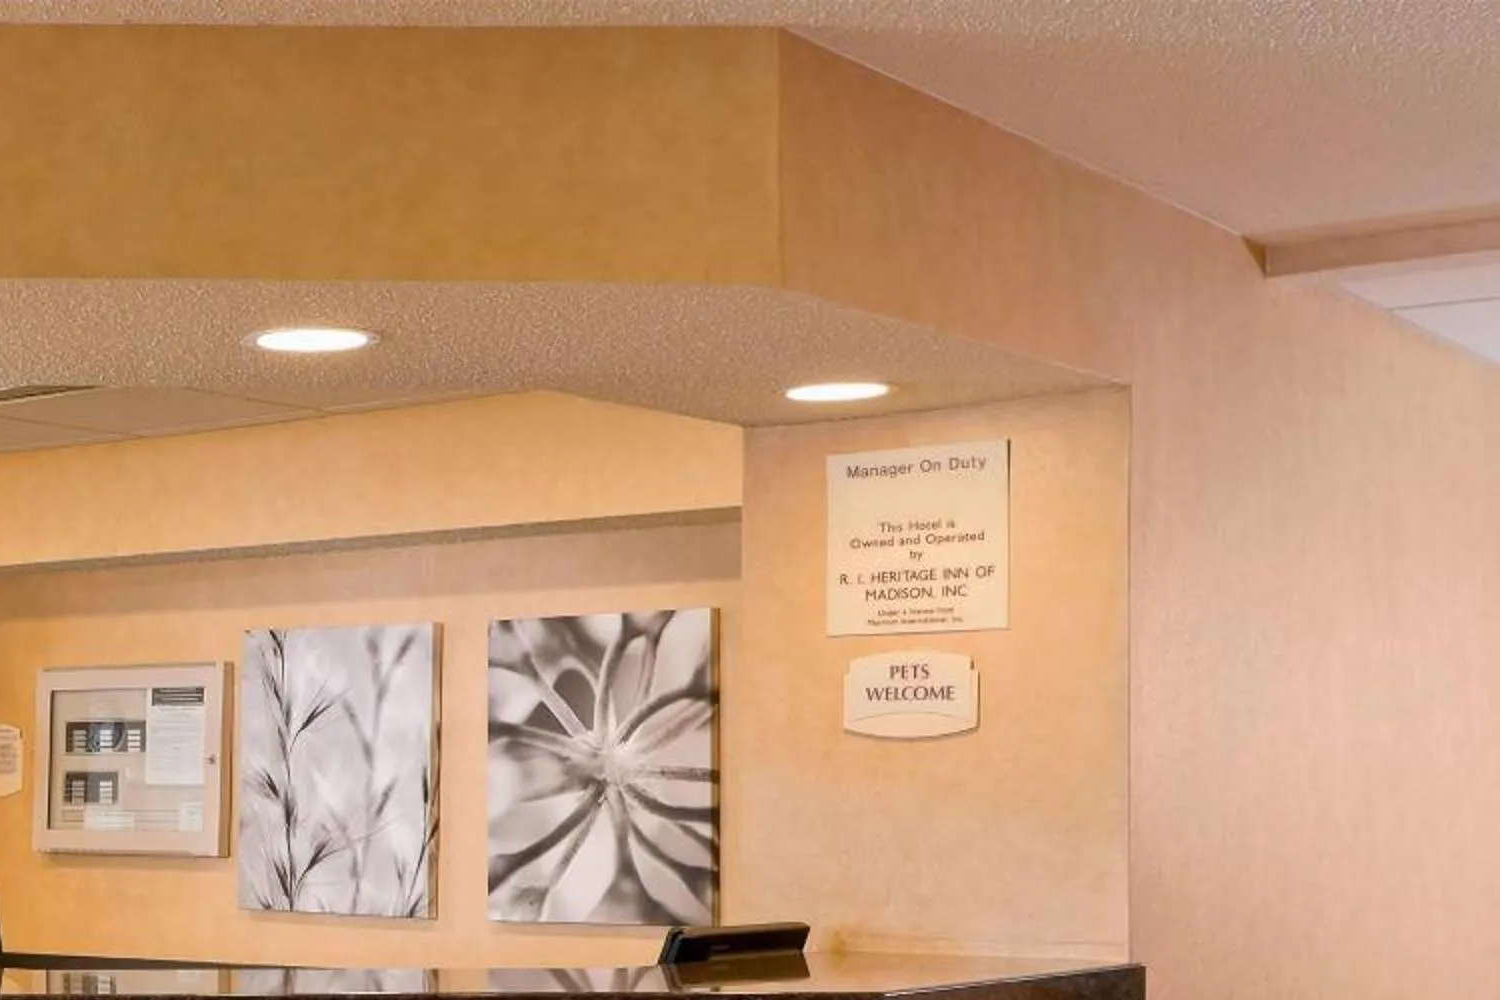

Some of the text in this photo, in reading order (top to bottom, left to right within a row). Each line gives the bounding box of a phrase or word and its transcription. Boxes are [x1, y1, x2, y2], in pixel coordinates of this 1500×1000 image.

[846, 456, 987, 479] Manager On Duty
[878, 518, 956, 533] This Hotel is
[849, 530, 986, 550] Owned and Operated
[909, 549, 923, 561] by
[870, 568, 937, 584] HERITAGE
[943, 567, 969, 580] INN
[975, 565, 996, 578] OF
[889, 663, 930, 680] PETS
[866, 685, 956, 701] WELCOME
